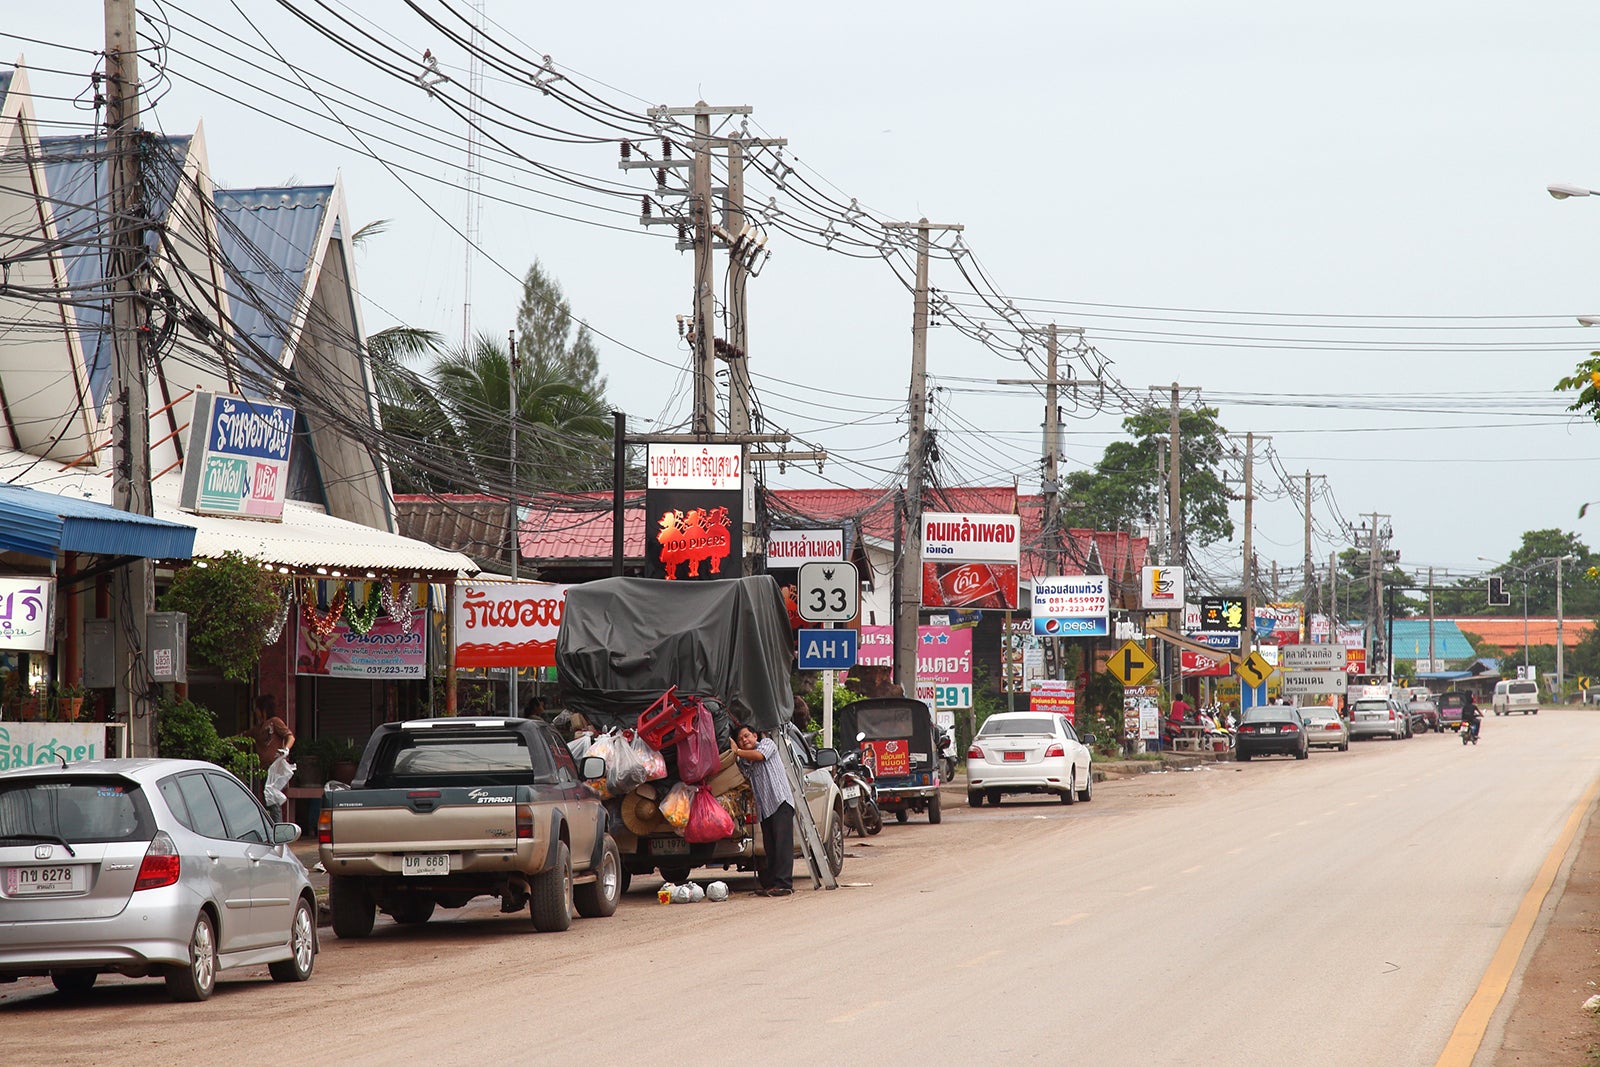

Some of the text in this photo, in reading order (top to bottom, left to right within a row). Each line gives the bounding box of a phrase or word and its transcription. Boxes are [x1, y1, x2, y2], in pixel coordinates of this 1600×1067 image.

[650, 447, 740, 487] บุญช่วย เจริญสุข 2
[667, 534, 726, 553] 100 PIPERS
[809, 587, 848, 613] 33
[1049, 596, 1106, 604] 081-4559970
[1063, 619, 1096, 632] pepsi
[805, 640, 849, 659] AH 1
[1336, 651, 1342, 660] 5
[366, 666, 419, 674] 037-223-732
[1286, 676, 1342, 687] พรมแดน 6
[477, 796, 513, 804] STRADA
[426, 856, 444, 867] 668
[42, 868, 72, 882] 6278
